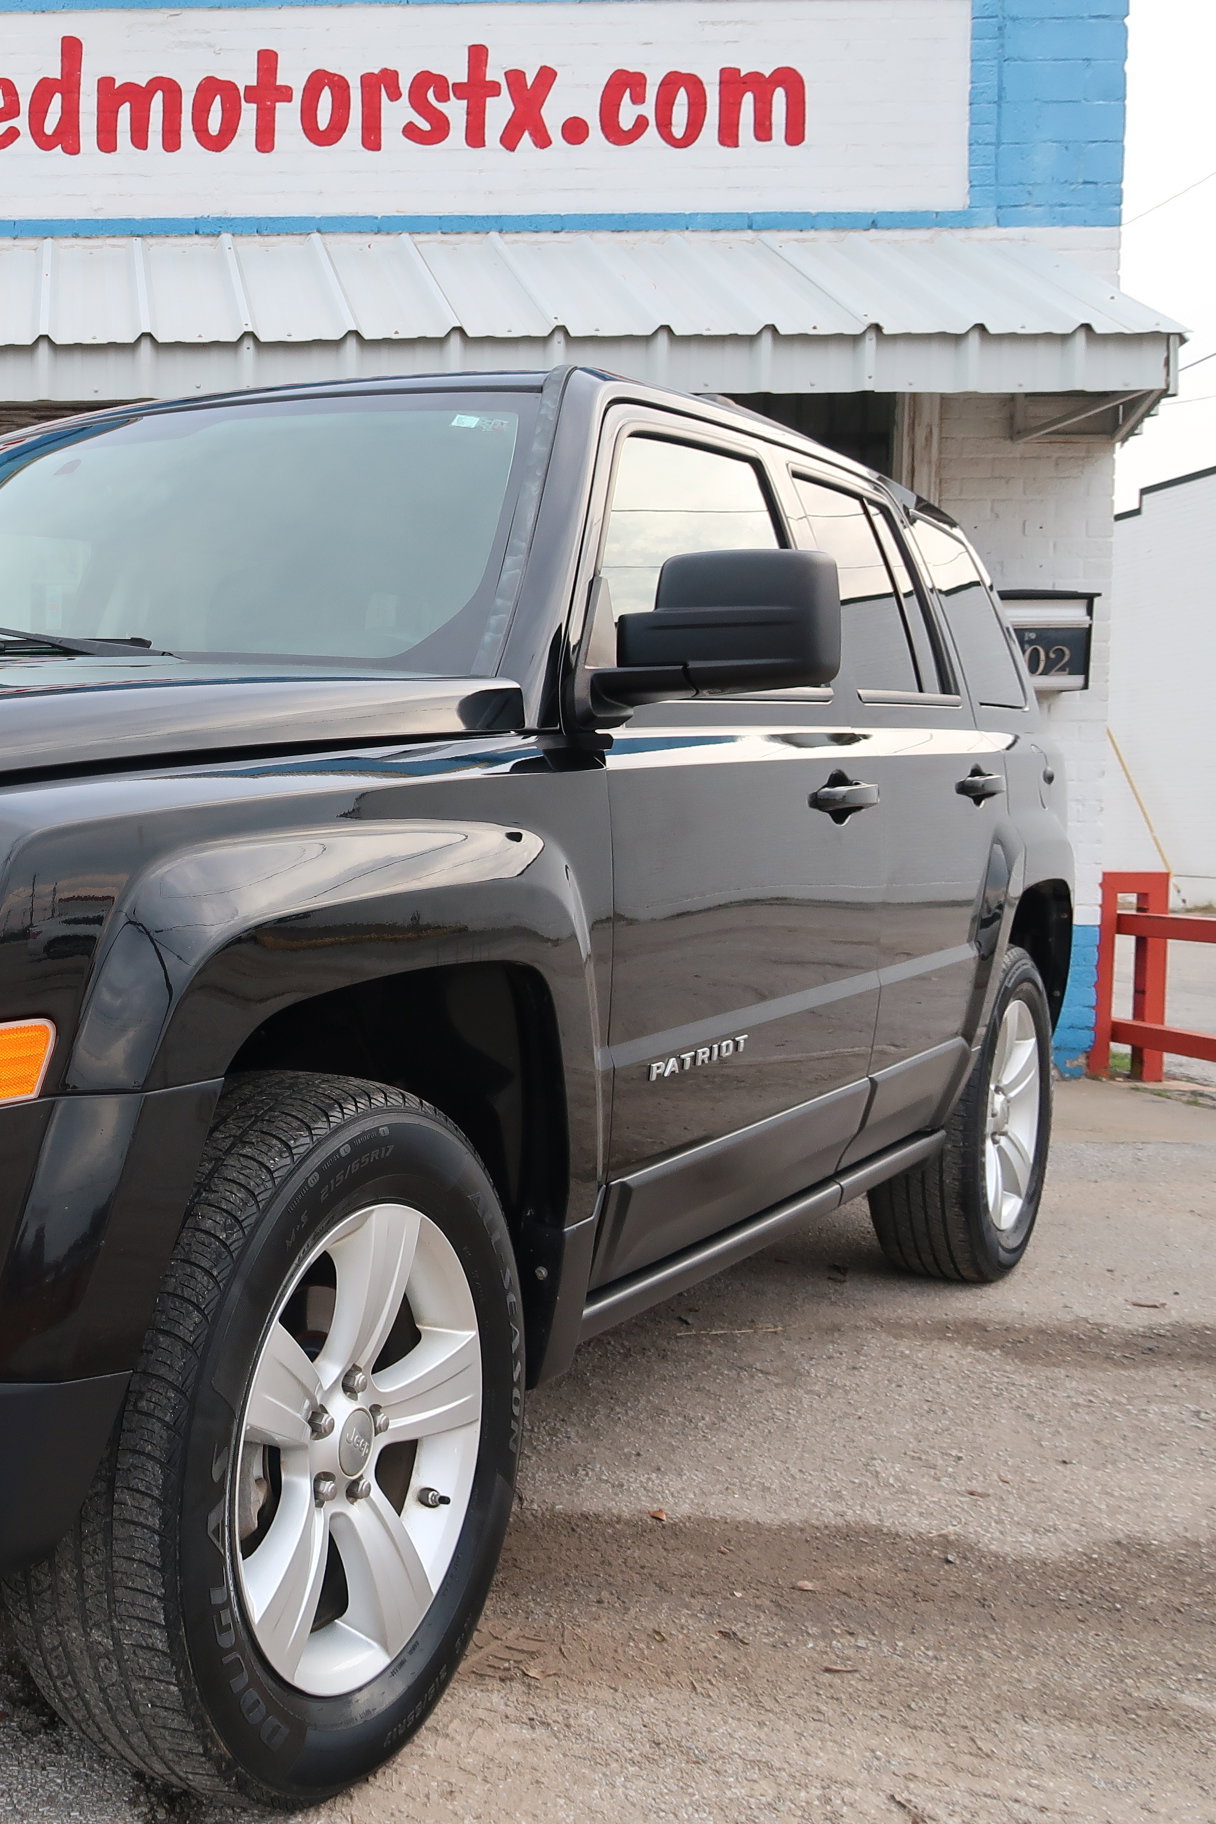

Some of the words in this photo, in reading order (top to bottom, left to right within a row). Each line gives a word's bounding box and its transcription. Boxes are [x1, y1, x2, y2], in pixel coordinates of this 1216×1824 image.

[648, 1034, 748, 1081] PATRIOT
[320, 1144, 395, 1201] 215/65R17
[346, 1427, 369, 1457] Jeep
[207, 1440, 290, 1751] DOUGLAS
